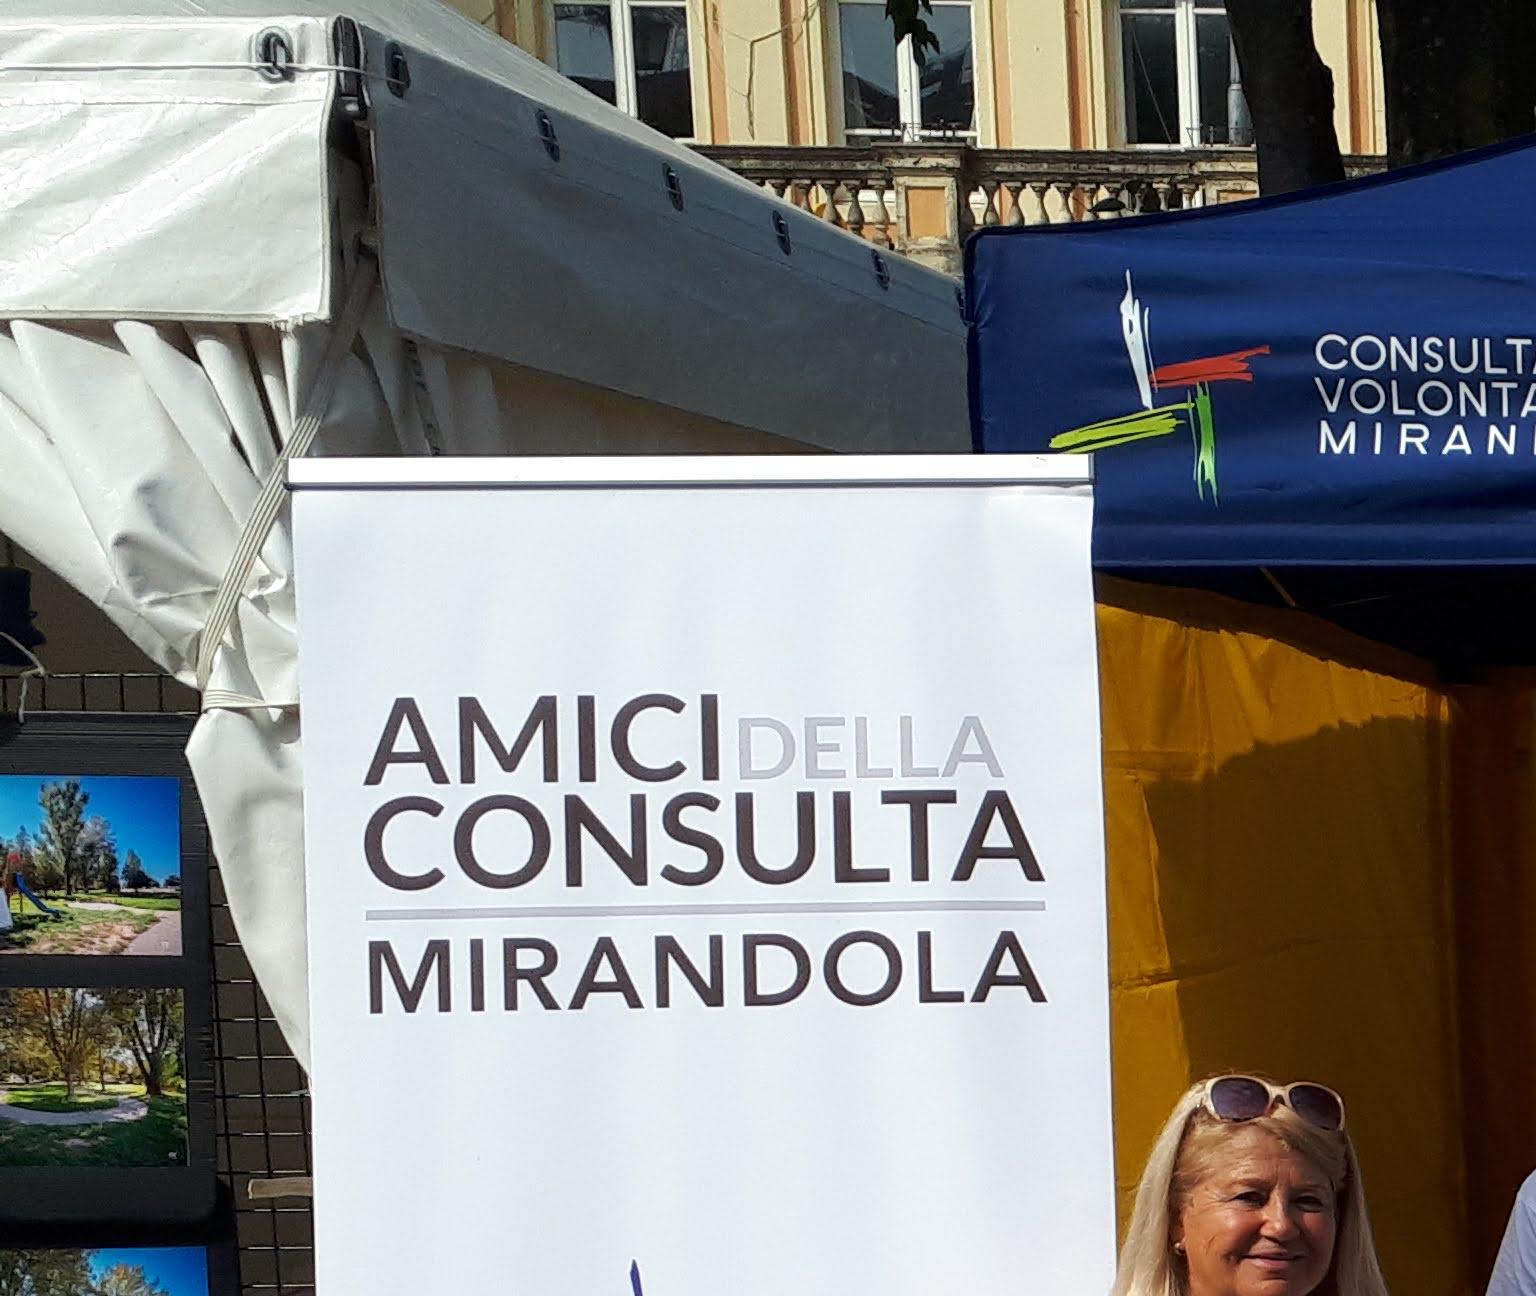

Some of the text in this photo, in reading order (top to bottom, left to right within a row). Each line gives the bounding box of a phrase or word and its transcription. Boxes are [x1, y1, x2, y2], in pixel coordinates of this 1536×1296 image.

[363, 693, 1005, 786] AMICI DELLA
[364, 790, 1046, 891] CONSULTA
[369, 930, 1048, 1014] MIRANDOLA
